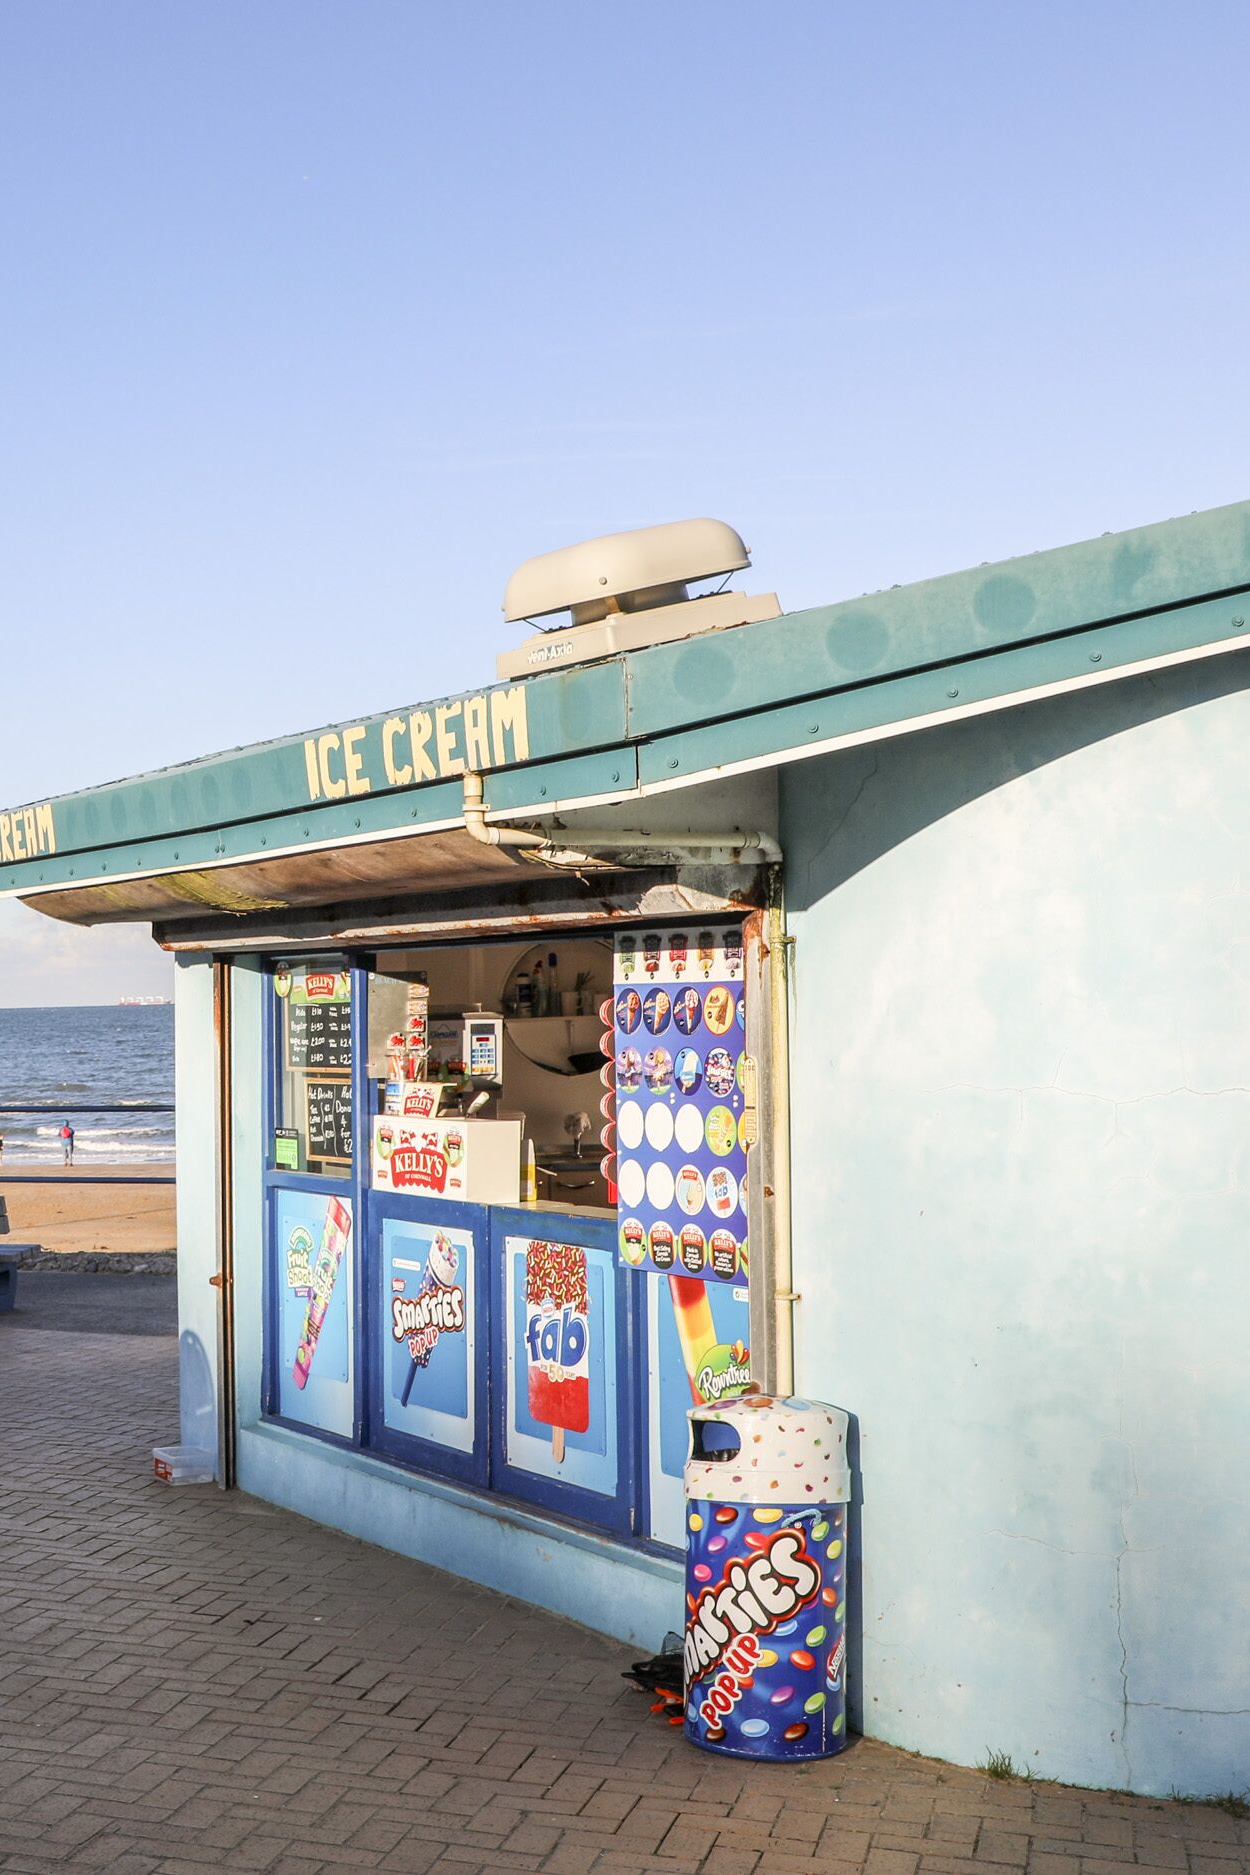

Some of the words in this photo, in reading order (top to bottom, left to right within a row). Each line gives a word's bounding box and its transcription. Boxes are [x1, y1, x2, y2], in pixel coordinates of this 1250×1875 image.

[527, 641, 573, 664] Vent-Axia
[303, 726, 371, 802] ICE
[382, 686, 529, 786] CREAM
[307, 976, 333, 989] KELLY'S
[406, 1098, 432, 1111] KELLY'S
[395, 1152, 443, 1178] KELLY'S
[288, 1251, 308, 1269] Fruit
[288, 1269, 312, 1285] Shoot
[393, 1288, 464, 1340] SMARTIES
[410, 1338, 426, 1355] POP
[426, 1329, 439, 1347] UP
[526, 1307, 587, 1367] fab
[549, 1364, 564, 1382] 50
[683, 1537, 815, 1690] MARTIES
[702, 1675, 741, 1730] POP
[724, 1634, 764, 1677] UP
